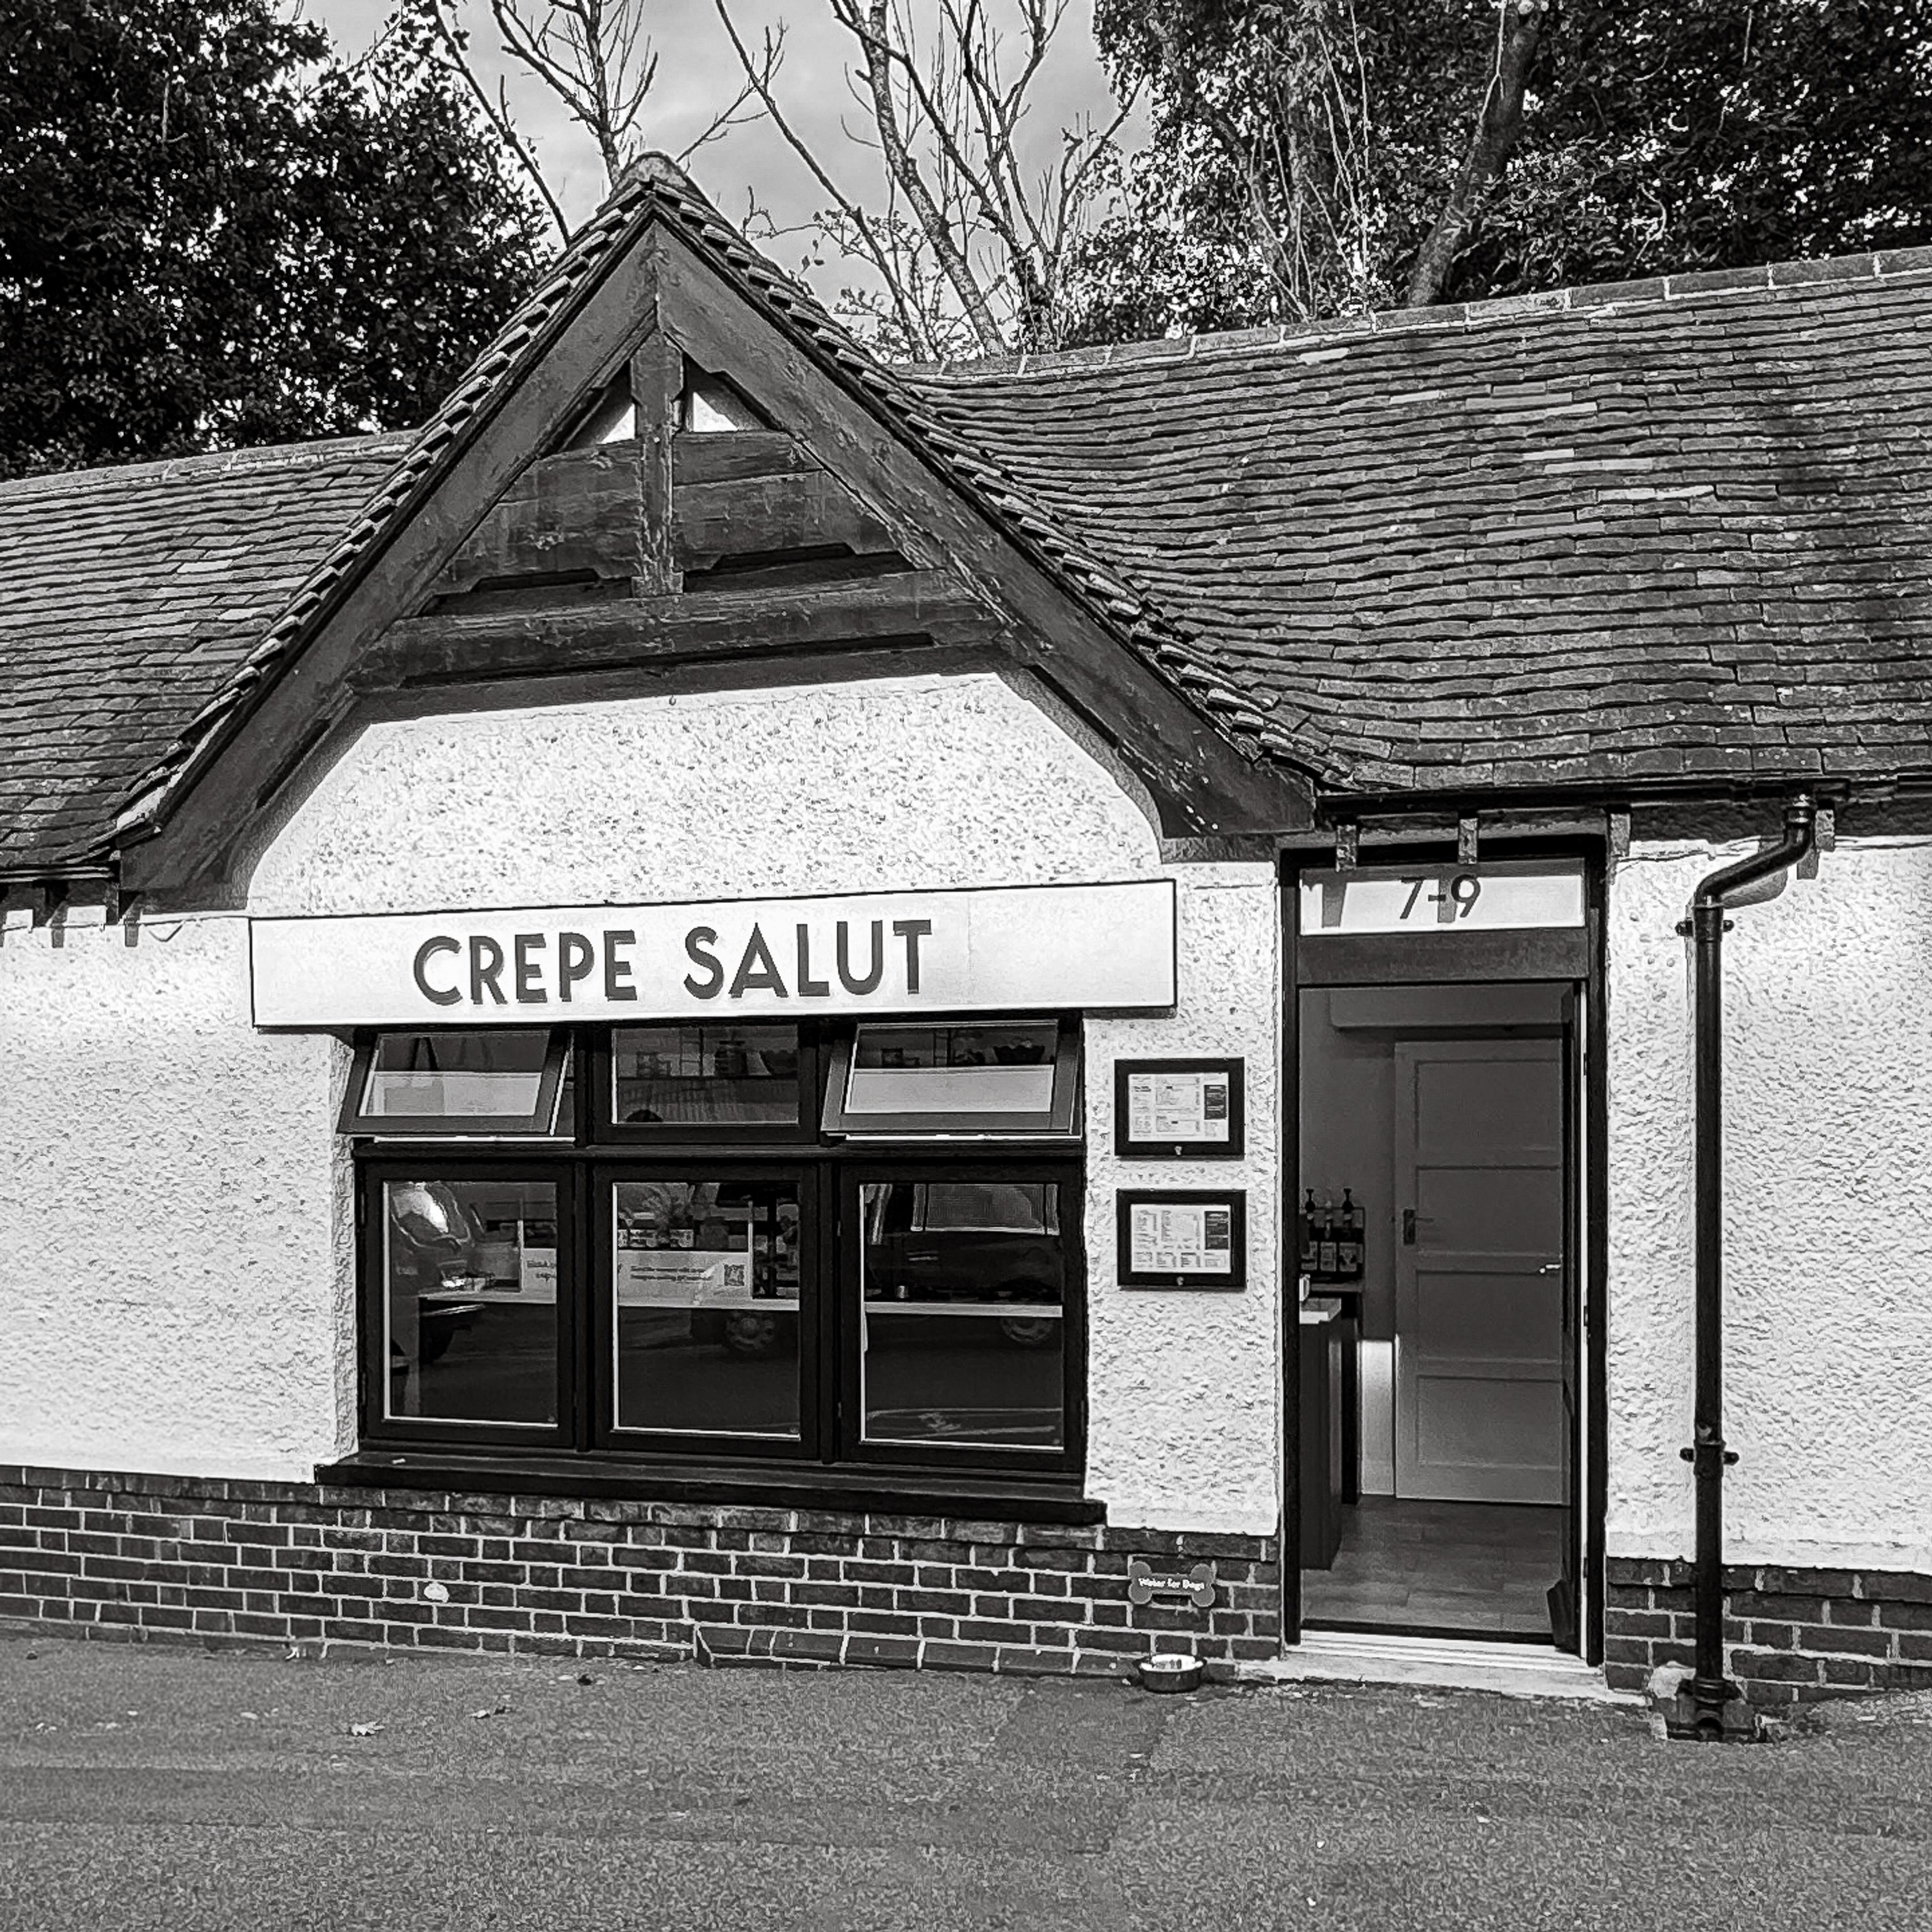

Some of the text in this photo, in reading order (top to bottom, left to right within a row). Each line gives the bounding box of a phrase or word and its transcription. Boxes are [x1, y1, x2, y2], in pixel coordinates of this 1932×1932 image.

[1399, 874, 1481, 919] 7-9
[414, 919, 932, 1006] CREPE SALUT
